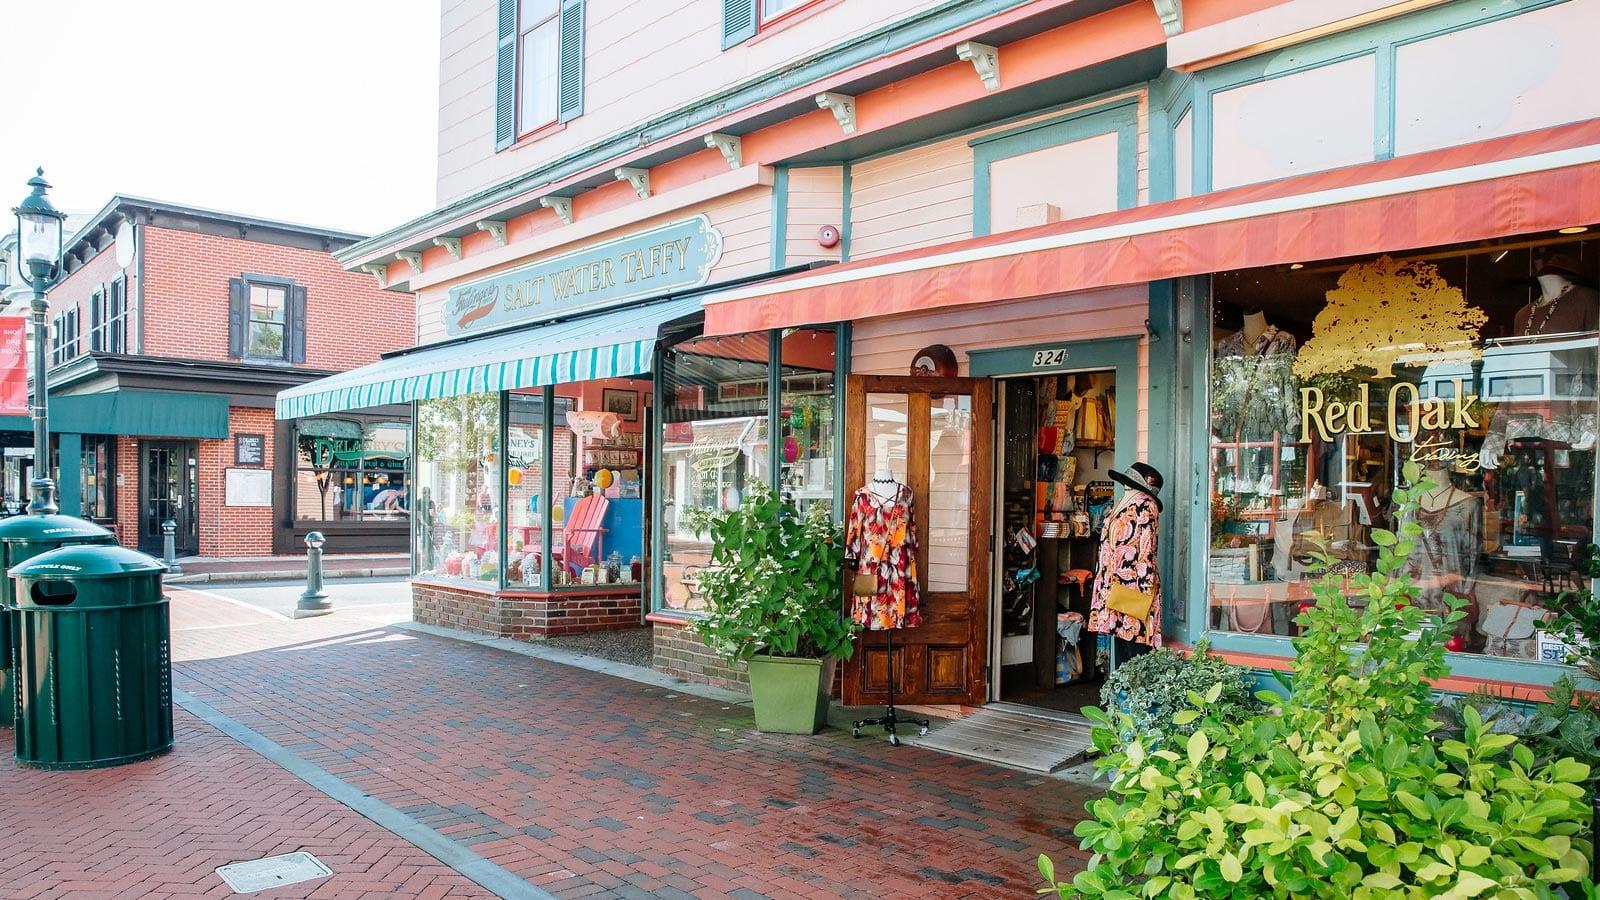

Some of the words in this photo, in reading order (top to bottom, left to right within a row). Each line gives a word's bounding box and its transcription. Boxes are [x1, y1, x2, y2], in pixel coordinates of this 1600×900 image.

[503, 277, 545, 312] SALT
[549, 258, 617, 301] WATER
[621, 236, 692, 284] TAFFY
[1034, 350, 1065, 366] 324
[1299, 383, 1371, 444] Red
[1388, 377, 1480, 443] Oak
